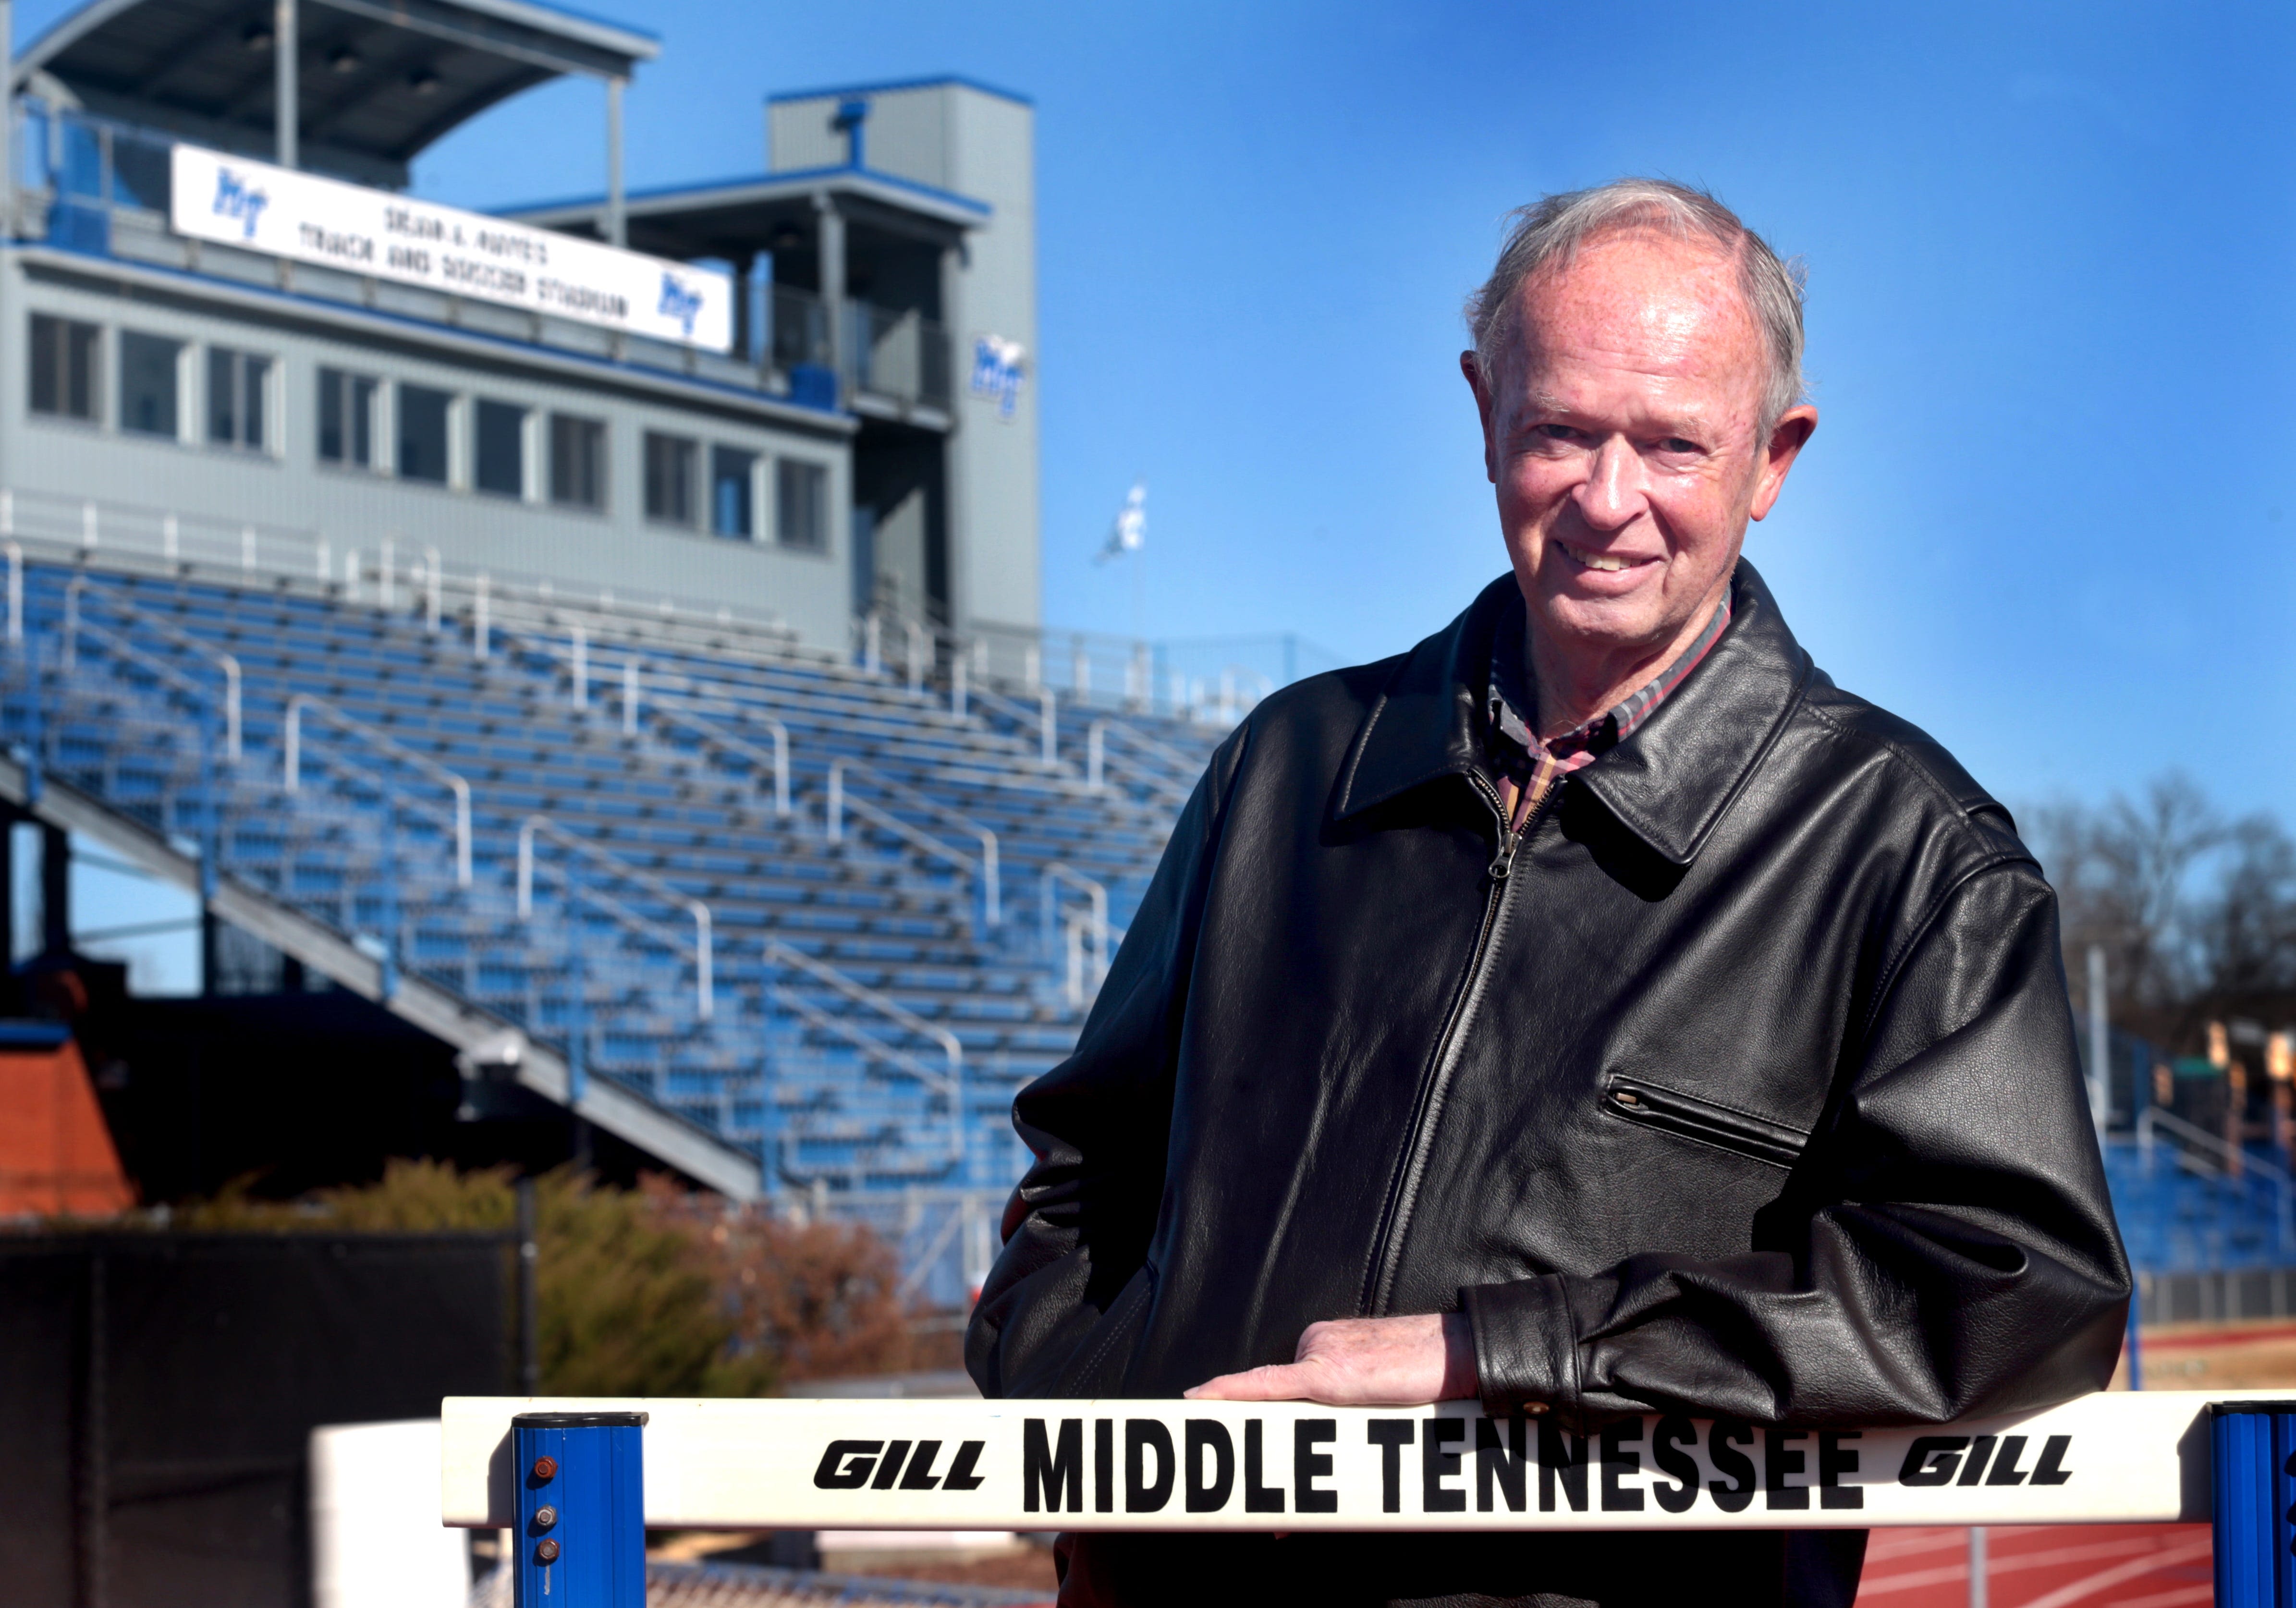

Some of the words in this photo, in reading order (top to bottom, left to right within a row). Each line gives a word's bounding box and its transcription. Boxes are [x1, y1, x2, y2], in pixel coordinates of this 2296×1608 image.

[298, 221, 374, 262] TRACK
[387, 244, 431, 274] AND
[442, 254, 526, 294] SOCCER
[537, 277, 630, 317] STADIUM
[814, 1440, 985, 1490] GILL
[1024, 1419, 1337, 1513] MIDDLE
[1368, 1415, 1864, 1513] TENNESSEE
[1898, 1435, 2071, 1486] GILL
